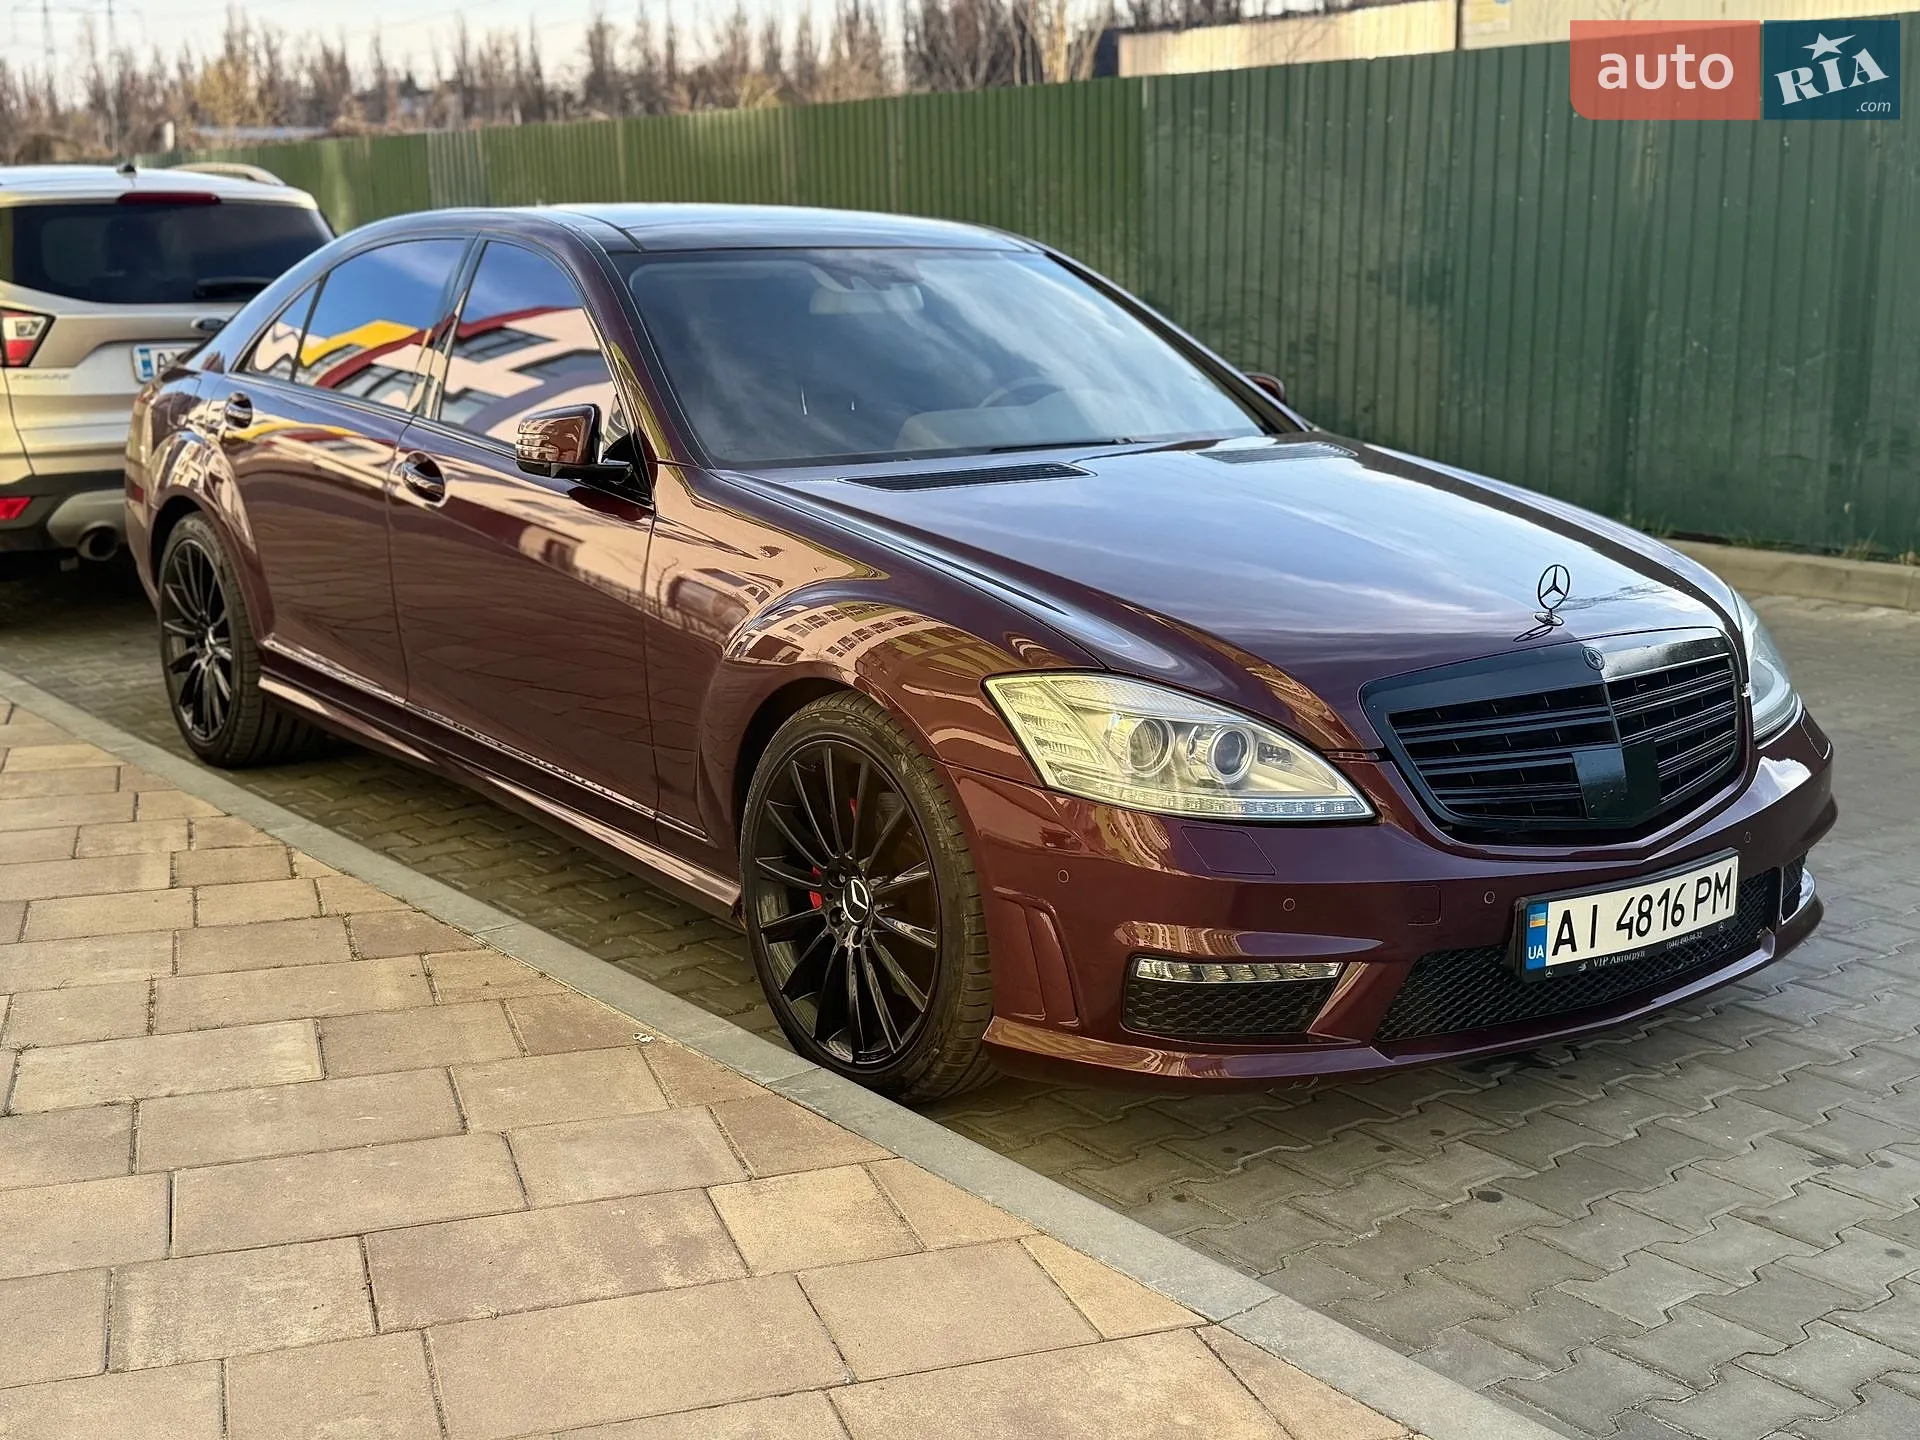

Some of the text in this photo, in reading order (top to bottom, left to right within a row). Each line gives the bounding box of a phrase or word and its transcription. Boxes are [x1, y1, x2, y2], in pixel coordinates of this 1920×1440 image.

[1551, 867, 1732, 957] AI 4816 PM
[1528, 946, 1545, 960] UA
[1593, 956, 1609, 967] VIP
